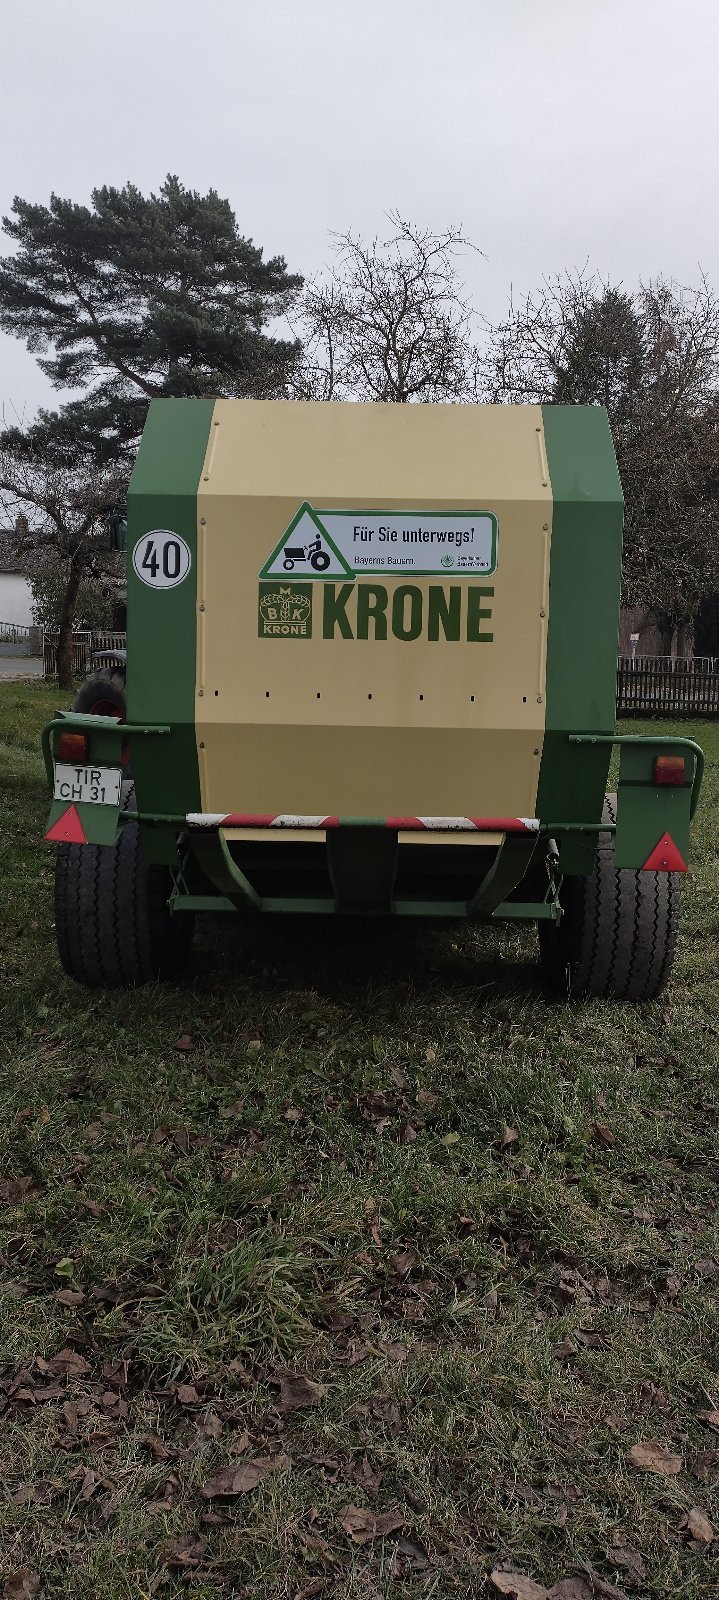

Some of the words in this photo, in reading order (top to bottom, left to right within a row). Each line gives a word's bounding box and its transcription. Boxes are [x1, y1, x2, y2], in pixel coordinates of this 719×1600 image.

[353, 526, 374, 543] Für
[378, 526, 398, 543] Sie
[402, 527, 475, 546] unterwegs!
[142, 541, 181, 578] 40
[354, 556, 385, 567] Bayerns
[387, 556, 416, 566] Bauern.
[279, 586, 291, 594] M
[322, 583, 495, 643] KRONE
[263, 624, 307, 635] KRONE
[75, 769, 102, 786] TIR
[60, 782, 83, 800] CH
[90, 786, 106, 802] 31
